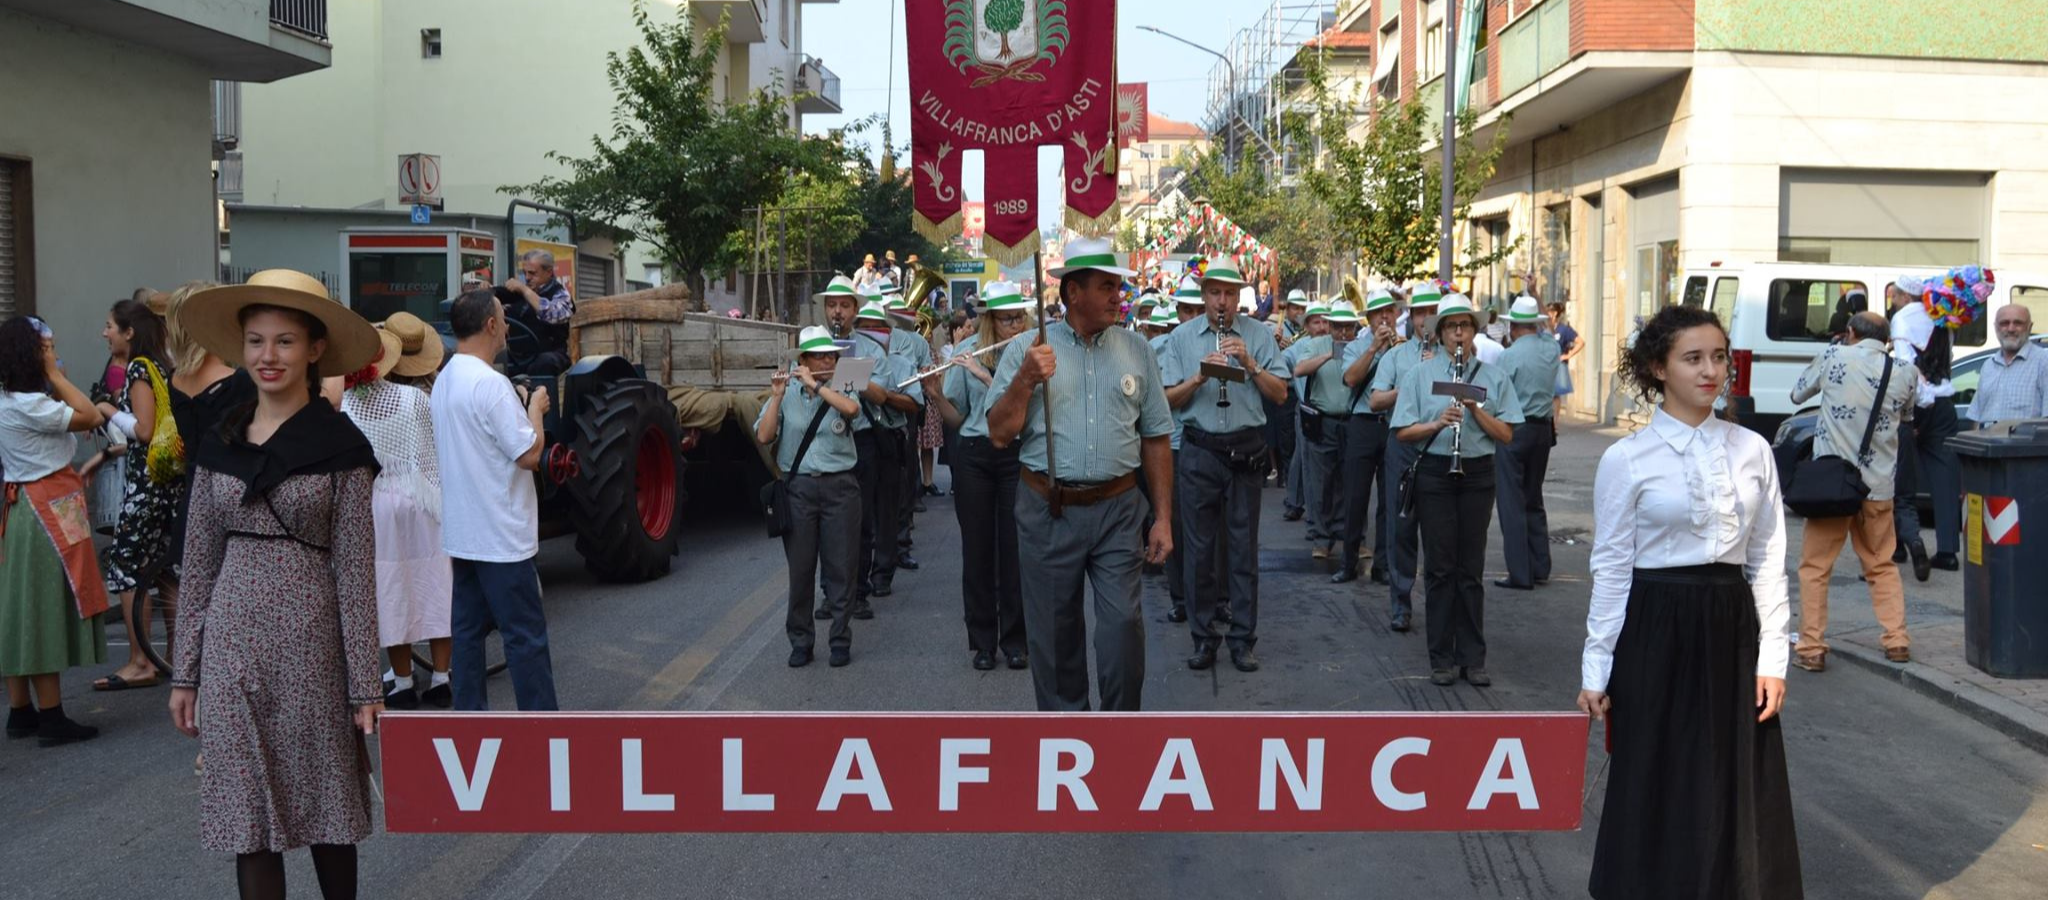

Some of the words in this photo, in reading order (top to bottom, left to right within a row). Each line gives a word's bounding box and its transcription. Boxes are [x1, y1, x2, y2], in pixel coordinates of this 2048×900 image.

[919, 89, 1043, 144] VILLAFRANCA
[1046, 77, 1102, 132] D'ASTI
[993, 199, 1028, 215] 1989
[433, 737, 1540, 812] VILLAFRANCA
